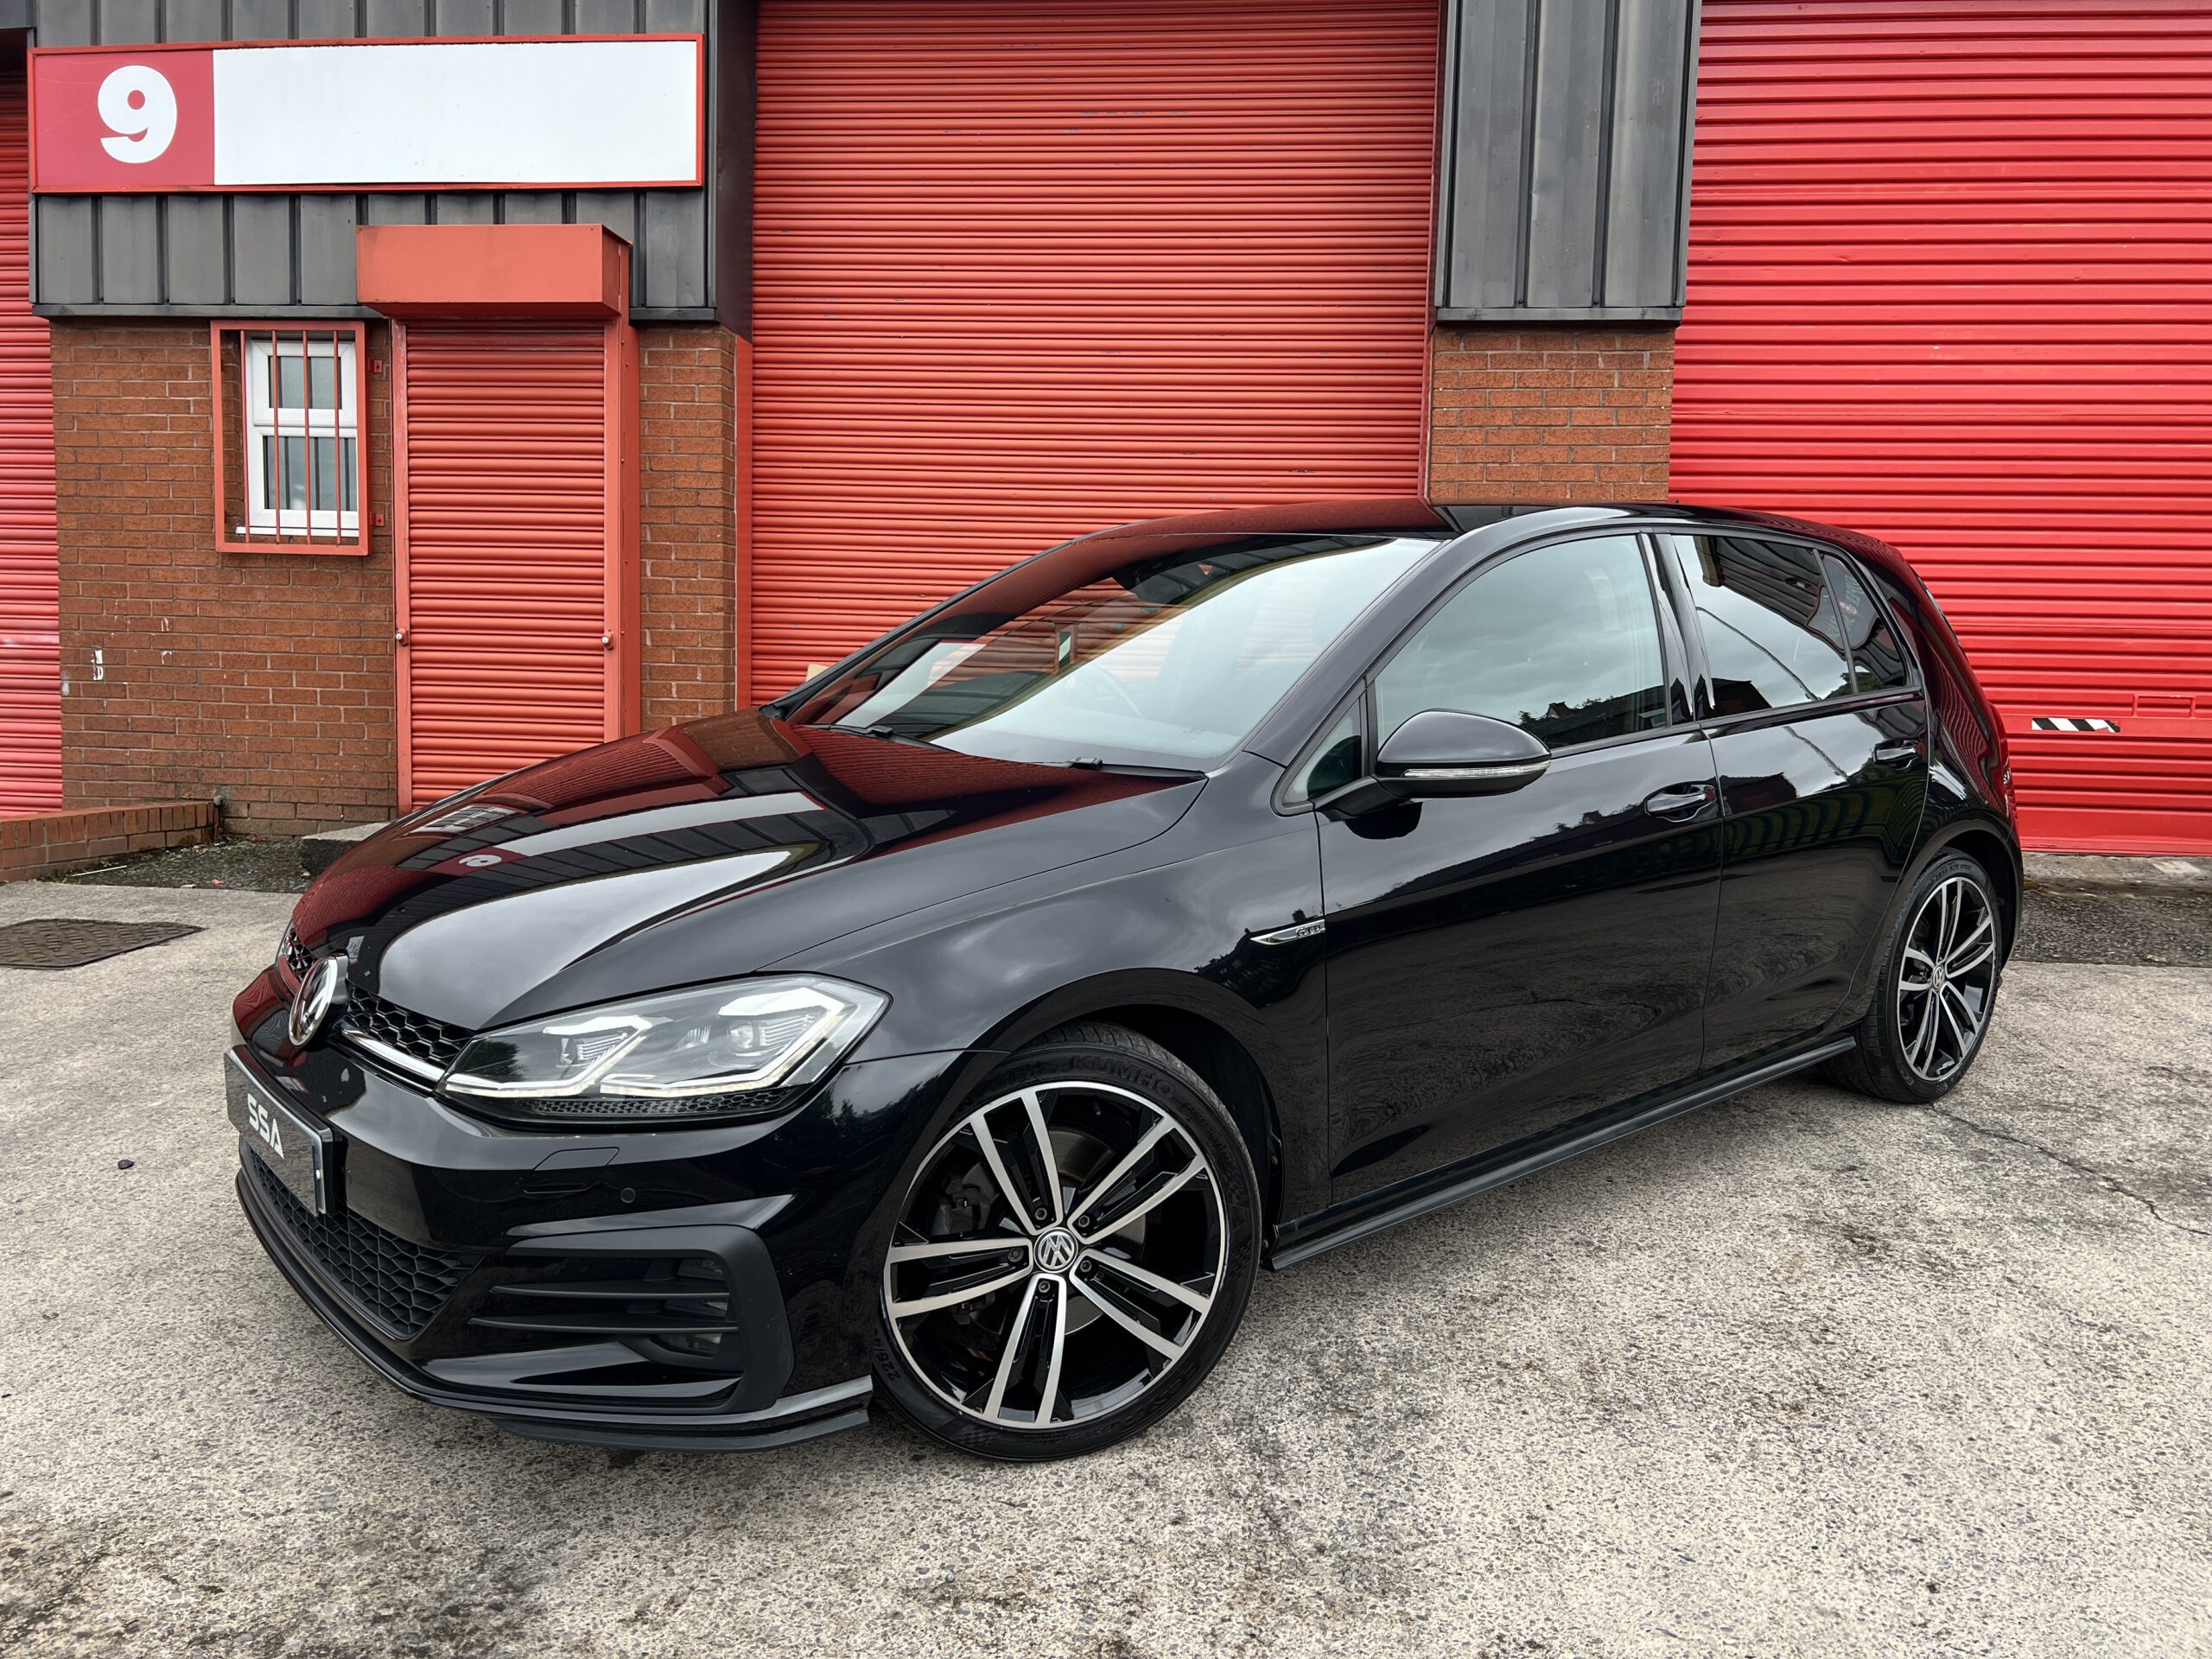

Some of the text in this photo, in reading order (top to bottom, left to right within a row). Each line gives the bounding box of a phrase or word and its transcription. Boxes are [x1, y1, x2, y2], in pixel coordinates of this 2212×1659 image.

[98, 65, 178, 164] 9
[1295, 924, 1321, 938] GTD
[1071, 1055, 1175, 1099] KUMHO
[247, 1092, 285, 1160] SSA
